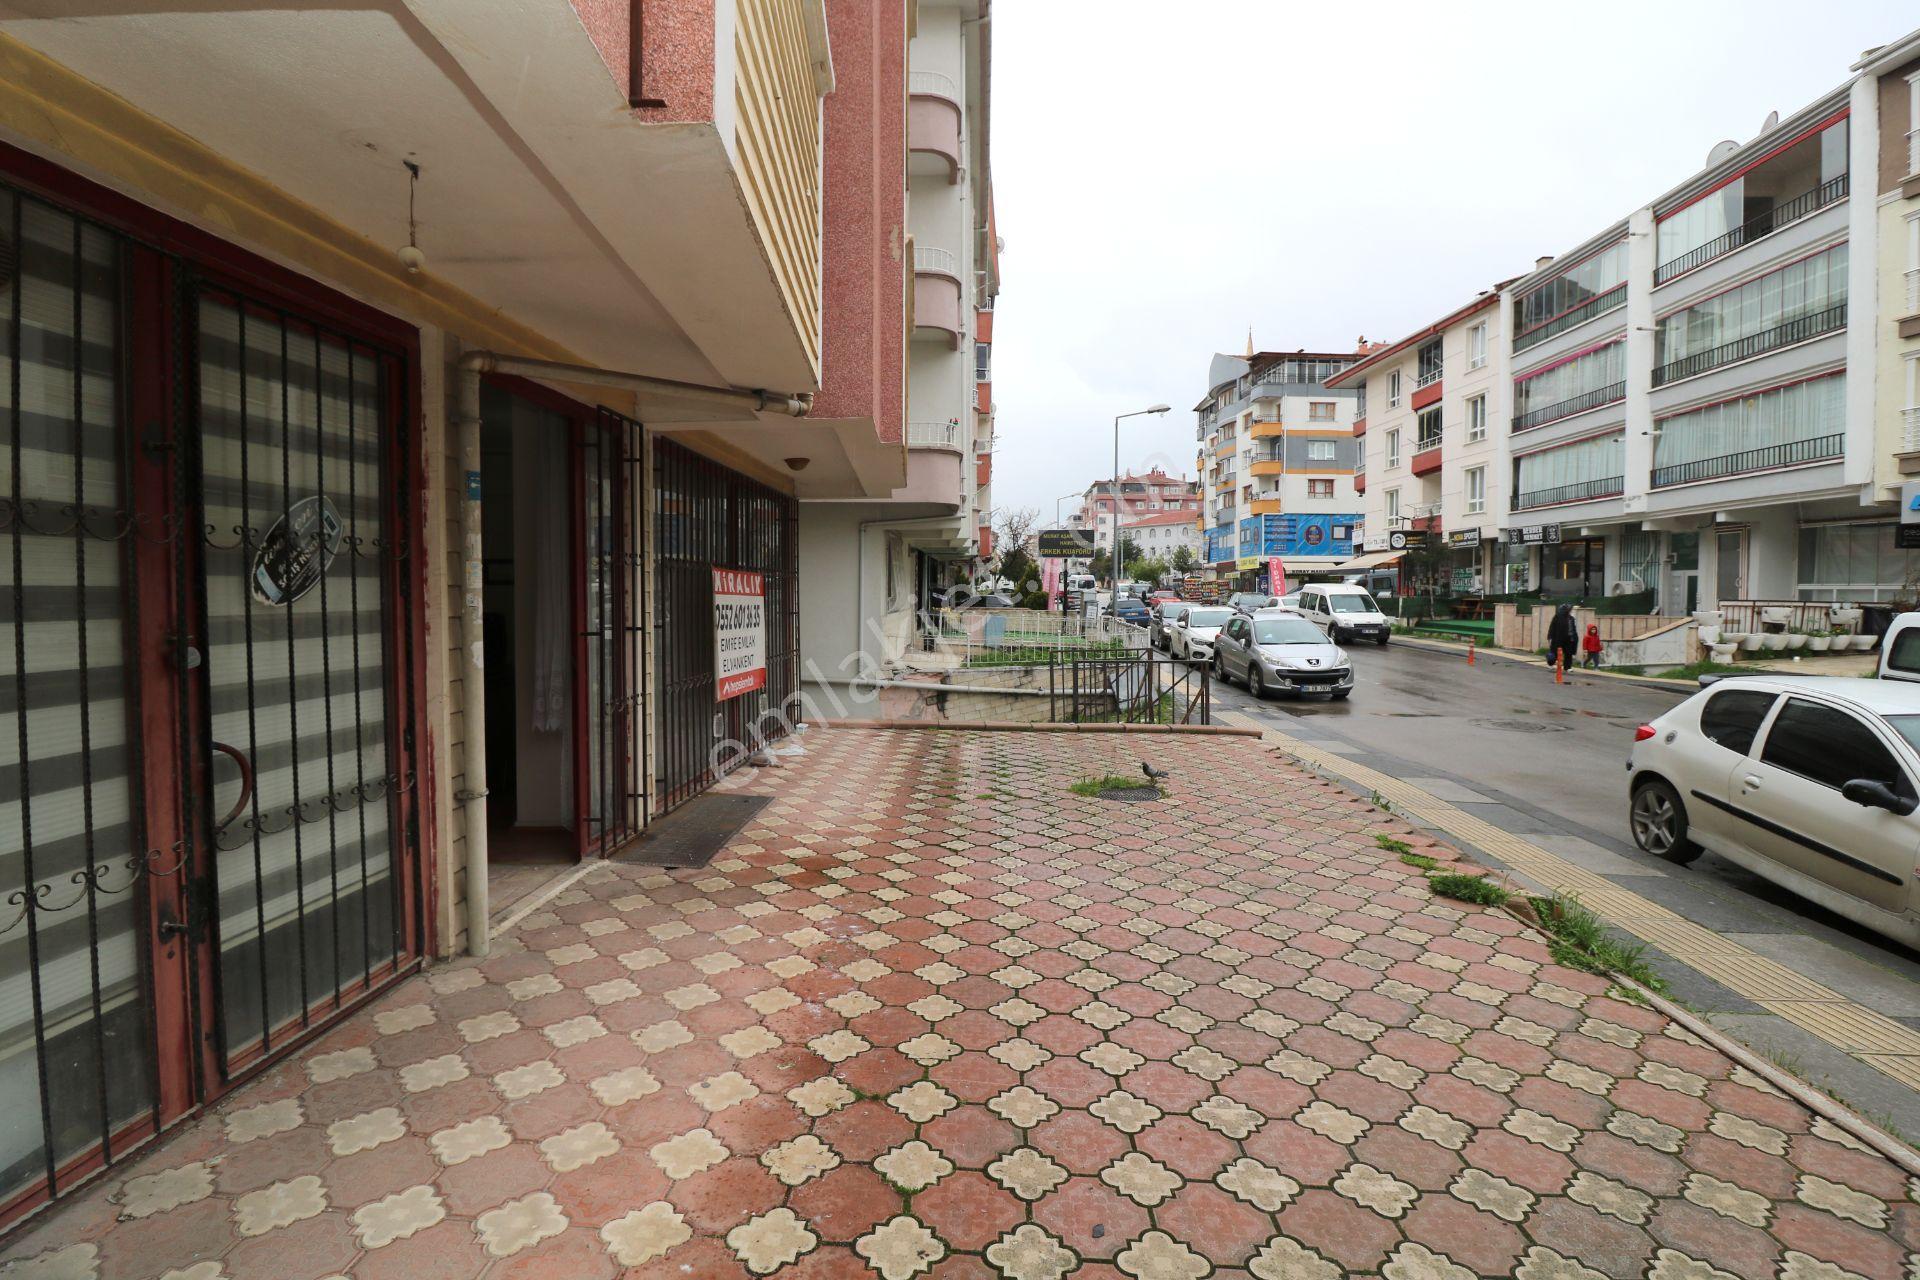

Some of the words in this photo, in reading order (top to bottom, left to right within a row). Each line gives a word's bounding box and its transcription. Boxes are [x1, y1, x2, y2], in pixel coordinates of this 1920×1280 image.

[720, 637, 737, 652] EMRE
[738, 635, 756, 650] EMLAK
[722, 654, 754, 673] ELVANKENT
